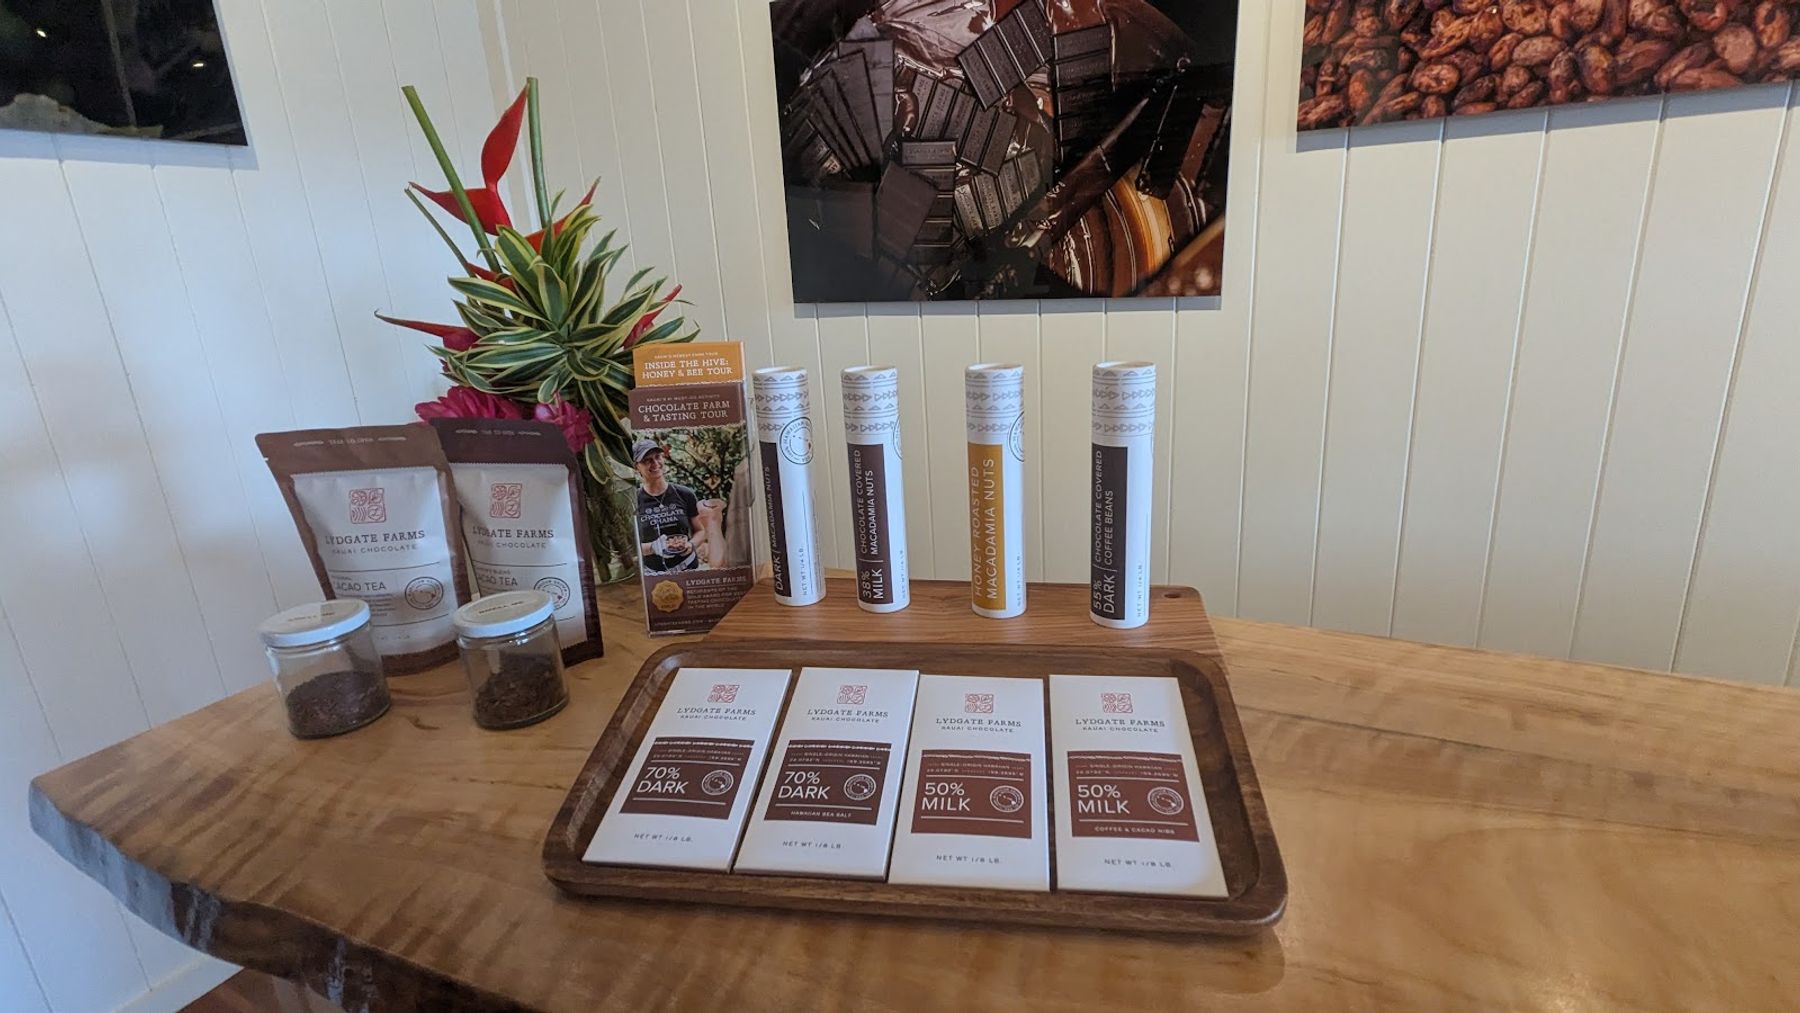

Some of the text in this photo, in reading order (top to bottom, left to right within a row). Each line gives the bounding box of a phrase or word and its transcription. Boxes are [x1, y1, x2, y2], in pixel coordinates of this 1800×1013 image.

[644, 358, 729, 370] INSIDE THE HIVE:
[642, 370, 675, 379] HONEY
[687, 368, 704, 376] BEE
[706, 367, 733, 375] TOUR
[638, 401, 730, 413] CHOCOLATE FARM
[653, 412, 696, 421] TASTING
[700, 410, 728, 419] TOUR
[854, 450, 867, 554] CHOCOLATE COVERED
[865, 471, 878, 554] MACADAMIA NUTS
[767, 494, 776, 547] MACADAMIA
[1104, 490, 1113, 565] COFFEE BEANS
[516, 529, 554, 538] FARMS
[971, 467, 982, 596] HONEY ROASTED
[983, 458, 997, 599] MACADAMIA NUTS
[325, 530, 425, 545] LYDGATE FARMS
[361, 544, 417, 554] CHOCOLATE
[773, 557, 783, 590] DARK
[365, 582, 387, 591] TEA
[499, 577, 518, 586] TEA
[686, 577, 721, 586] LYDGATE
[861, 571, 871, 598] 38%
[872, 569, 884, 599] MILK
[1094, 580, 1102, 610] 55%
[1103, 575, 1115, 613] DARK
[856, 710, 889, 718] FARMS
[988, 719, 1022, 727] FARMS
[1130, 719, 1165, 727] FARMS
[645, 766, 681, 780] 70%
[784, 771, 821, 785] 70%
[636, 780, 688, 794] DARK
[778, 786, 831, 800] DARK
[924, 782, 965, 796] 50%
[1078, 784, 1121, 798] 50%
[921, 797, 971, 812] MILK
[1078, 800, 1130, 814] MILK
